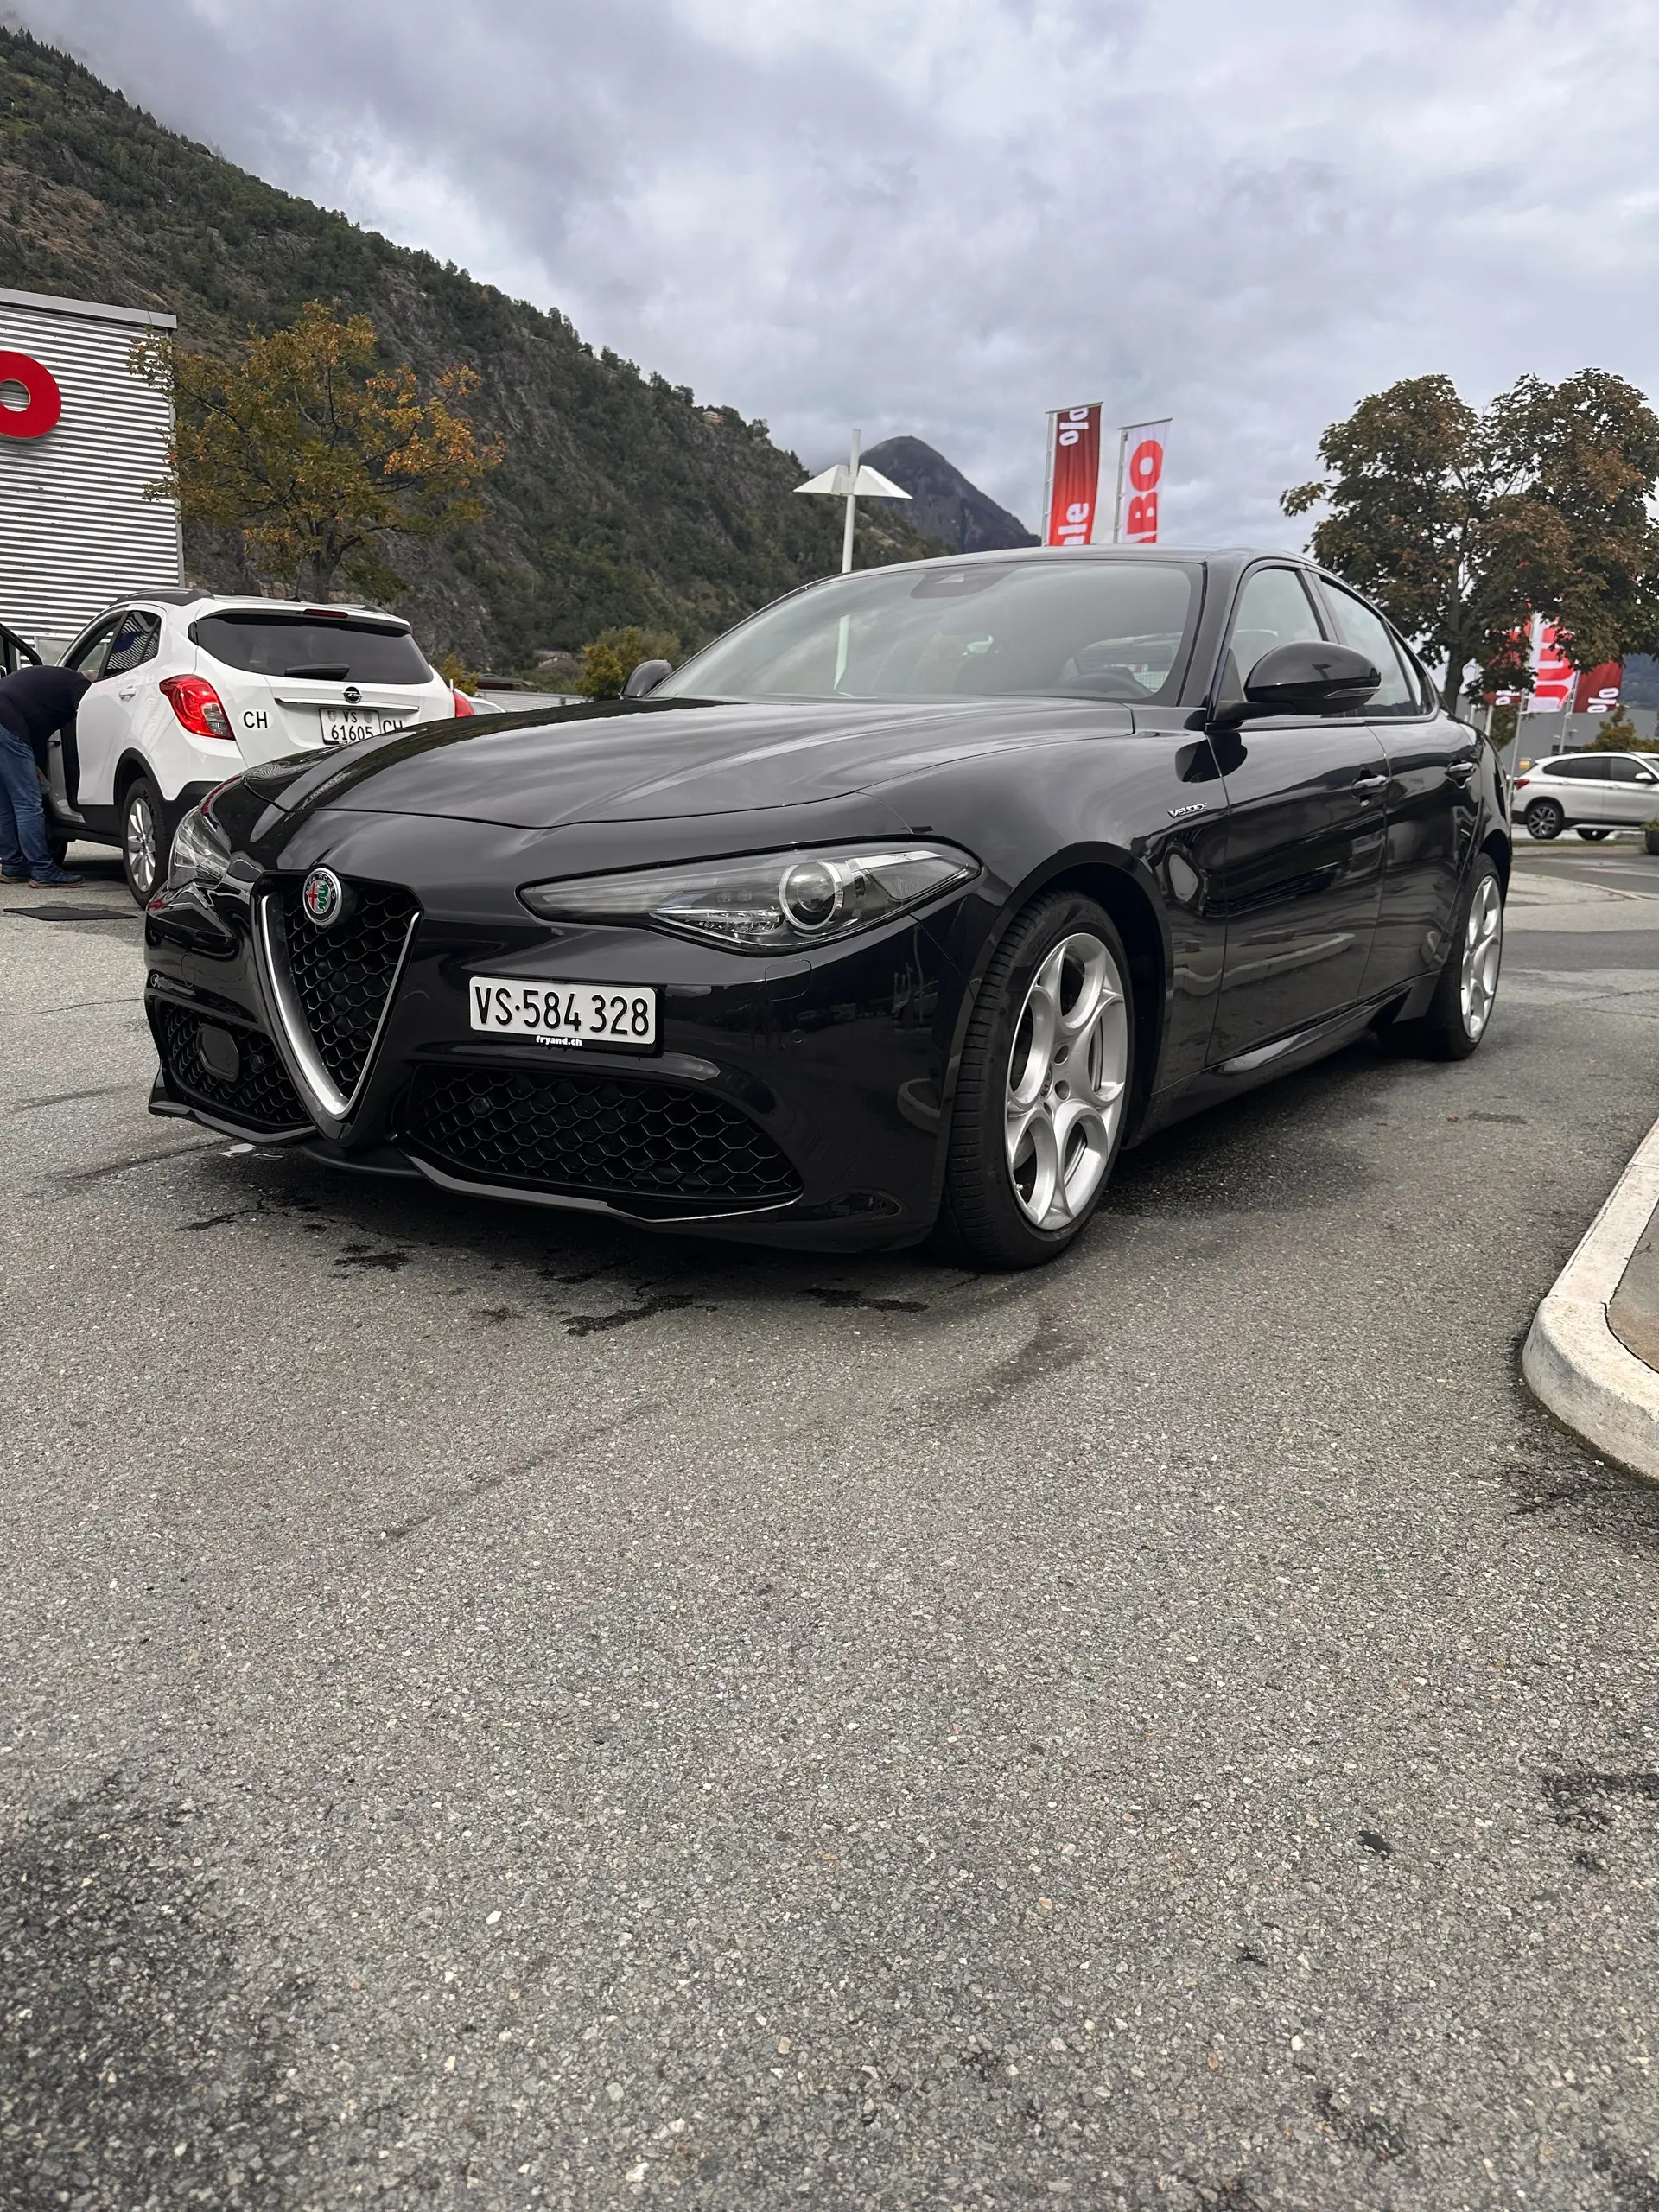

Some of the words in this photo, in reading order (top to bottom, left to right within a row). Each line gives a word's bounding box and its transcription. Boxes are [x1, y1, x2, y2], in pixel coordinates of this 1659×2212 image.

[1127, 440, 1164, 543] BO
[243, 711, 268, 728] CH
[342, 710, 358, 723] VS
[589, 995, 649, 1036] 328
[536, 1035, 582, 1046] fryand.ch
